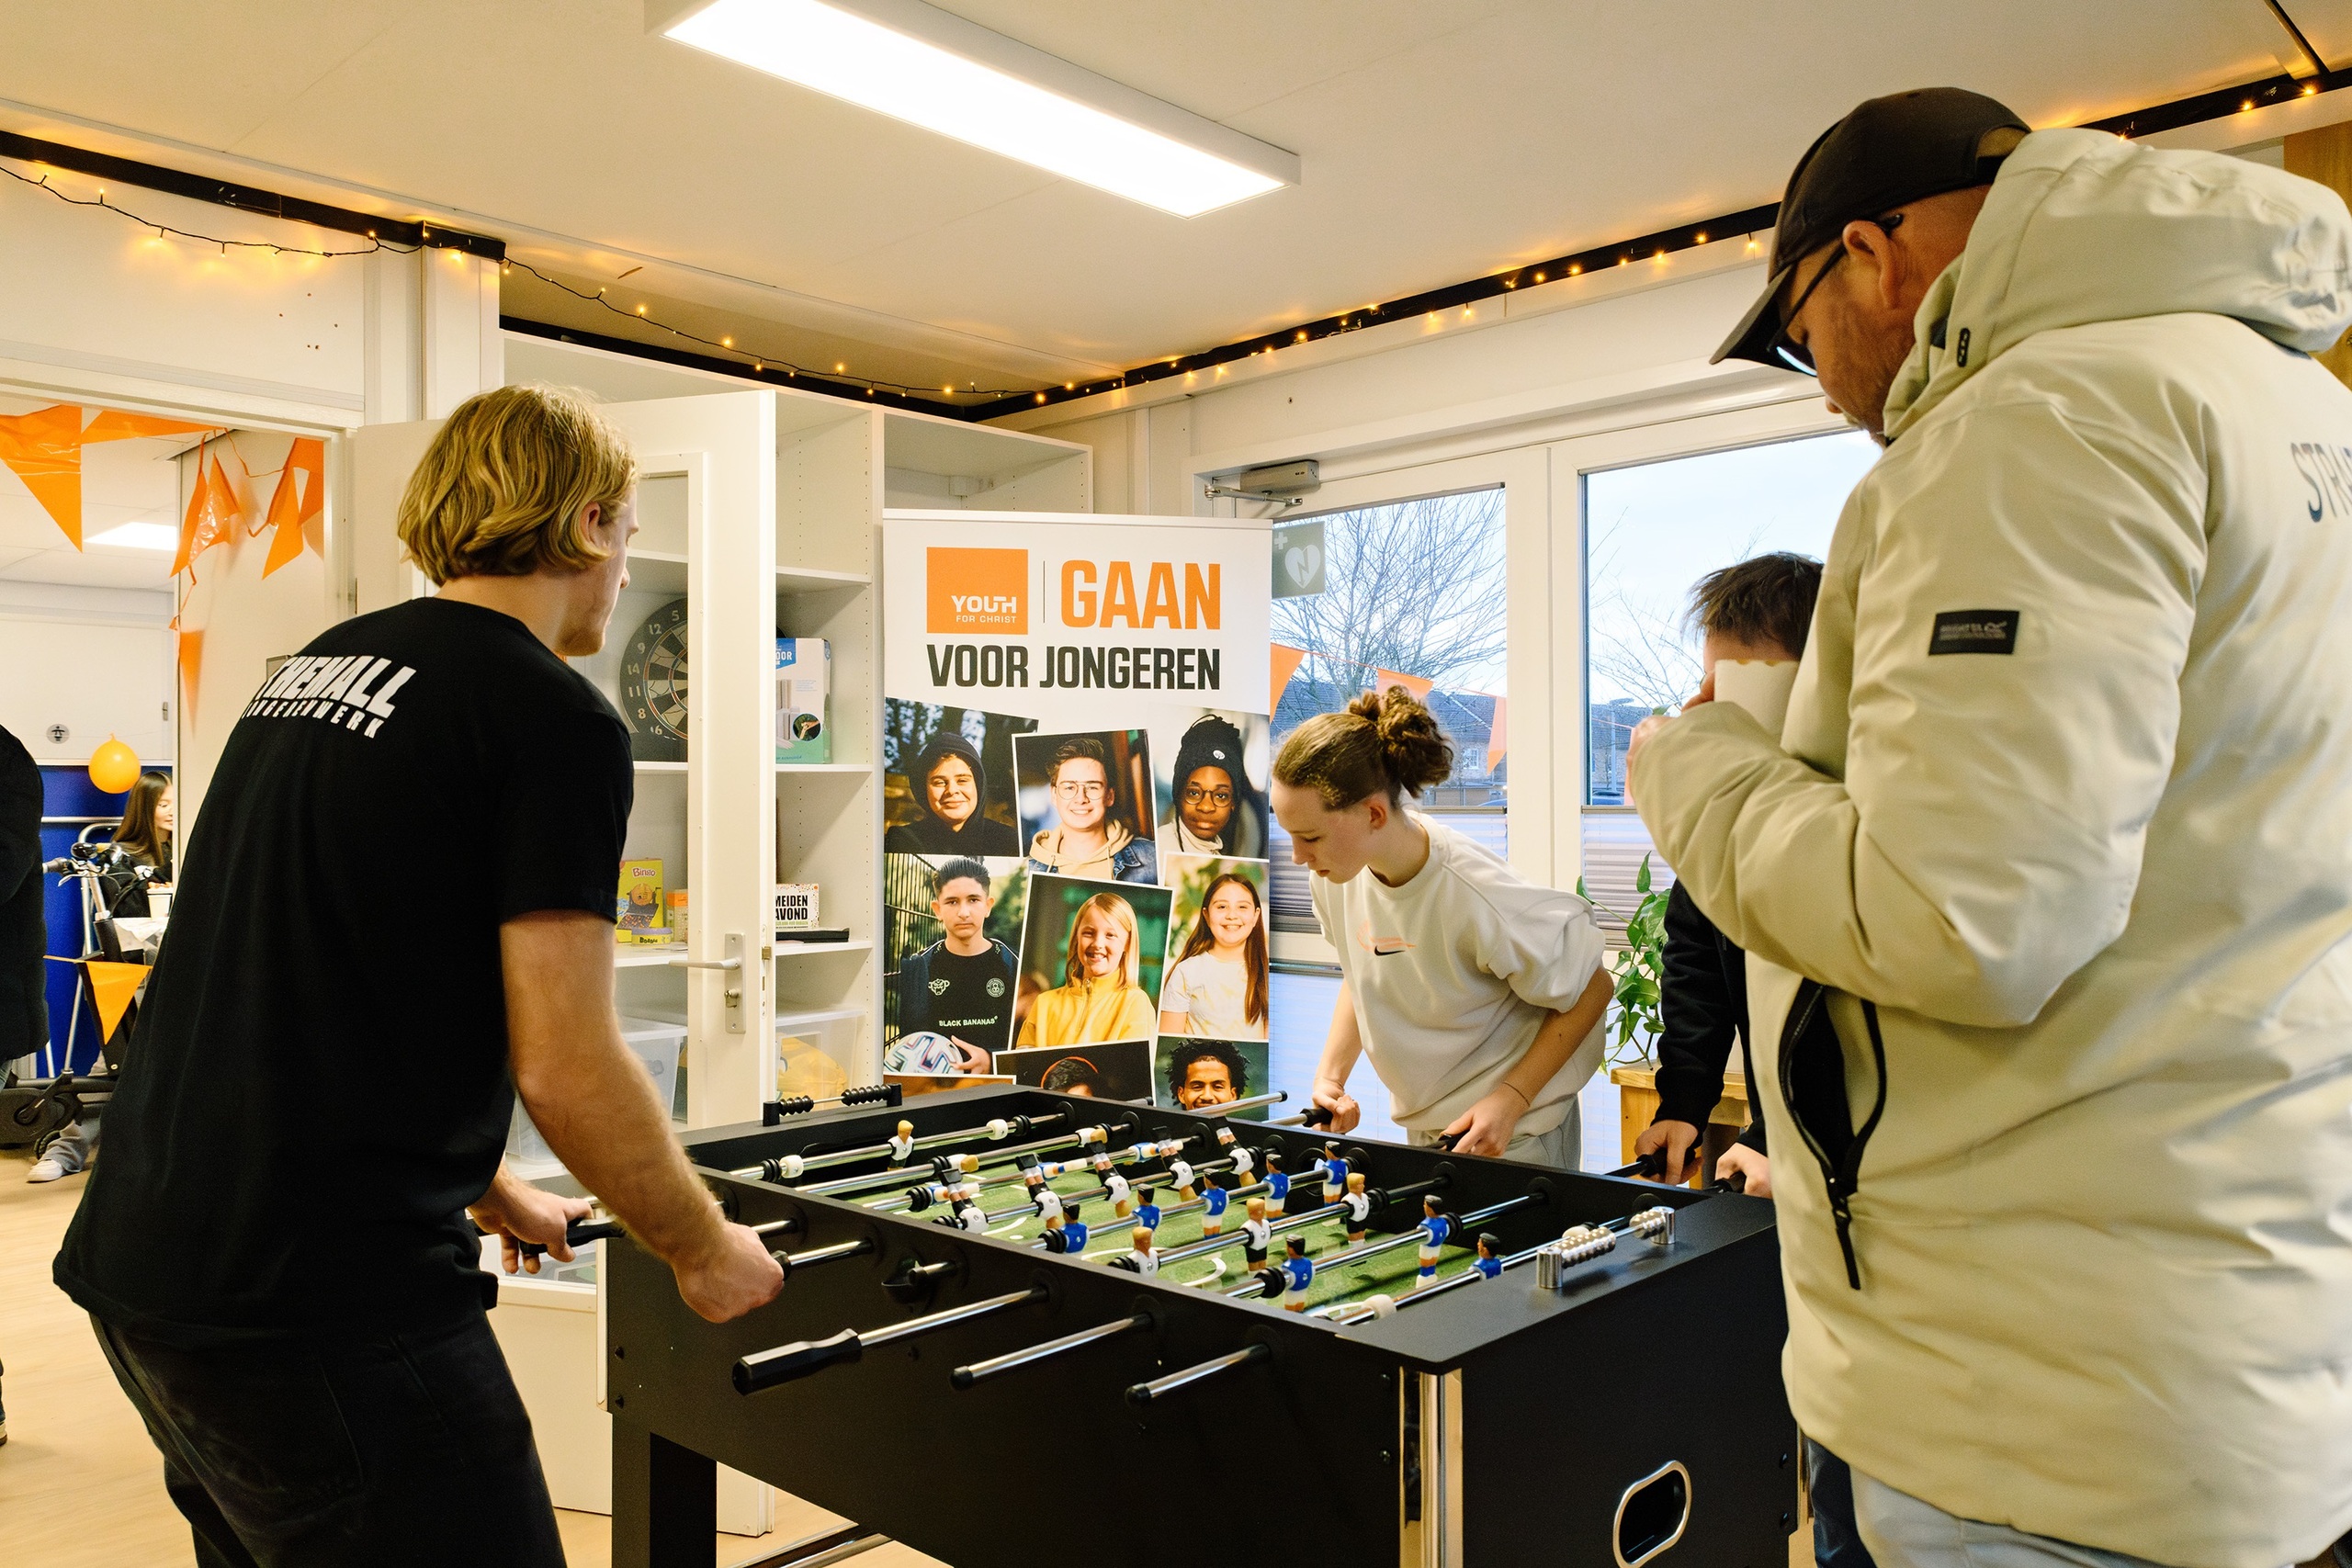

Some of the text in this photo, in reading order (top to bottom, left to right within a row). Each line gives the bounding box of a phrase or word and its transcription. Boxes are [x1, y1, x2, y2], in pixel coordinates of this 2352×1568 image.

[1061, 559, 1221, 630] GAAN
[951, 594, 1017, 614] YOUTH
[672, 610, 680, 622] 5
[956, 615, 1017, 624] FOR CHRIST
[649, 623, 662, 636] 12
[638, 643, 646, 654] 9
[627, 663, 640, 675] 14
[926, 644, 1221, 690] VOOR JONGEREN
[628, 685, 641, 698] 11
[637, 708, 647, 719] 8
[632, 867, 657, 878] Bingo
[938, 1019, 962, 1027] BLACK
